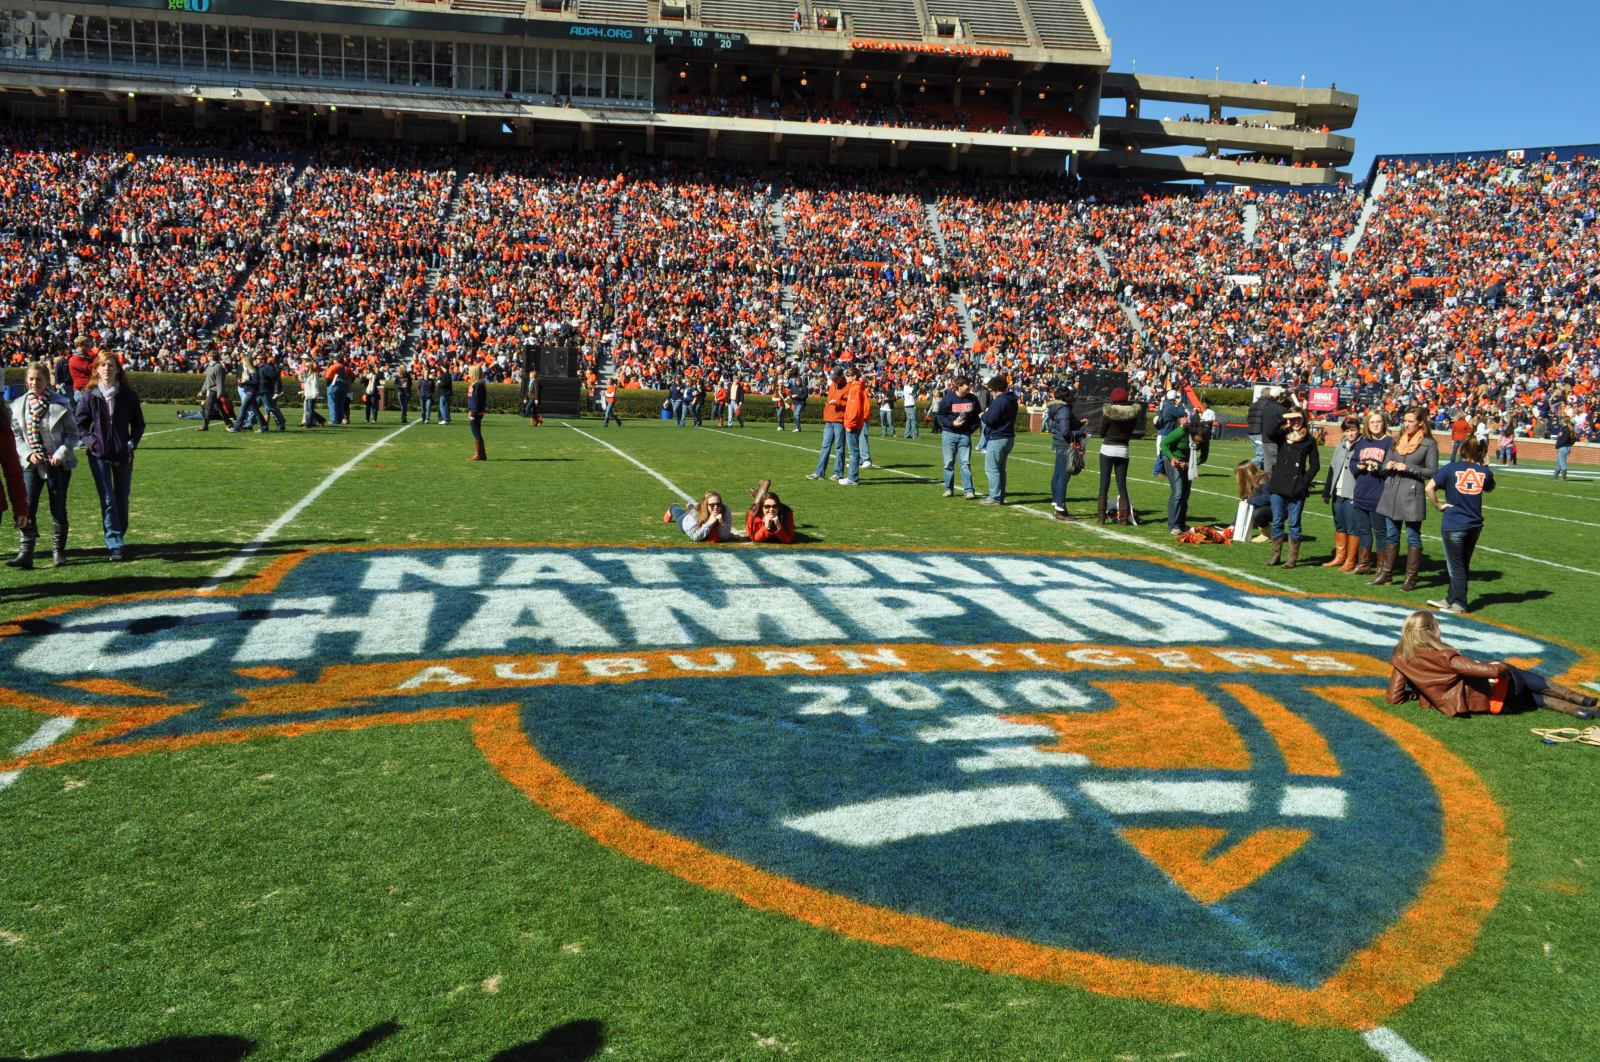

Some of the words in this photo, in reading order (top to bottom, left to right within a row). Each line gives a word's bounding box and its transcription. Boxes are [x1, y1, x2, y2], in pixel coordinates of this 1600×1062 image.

[570, 26, 633, 38] ADPH.ORG
[647, 35, 653, 44] 4
[669, 36, 674, 45] 1
[692, 38, 703, 47] 10
[720, 40, 732, 48] 20
[950, 44, 1009, 58] STADIUM
[360, 554, 1208, 594] NATIONAL
[14, 586, 1544, 676] CHAMPIONS
[395, 646, 908, 692] AUBURN
[949, 646, 1356, 674] TIGERS
[786, 677, 1092, 716] 2010
